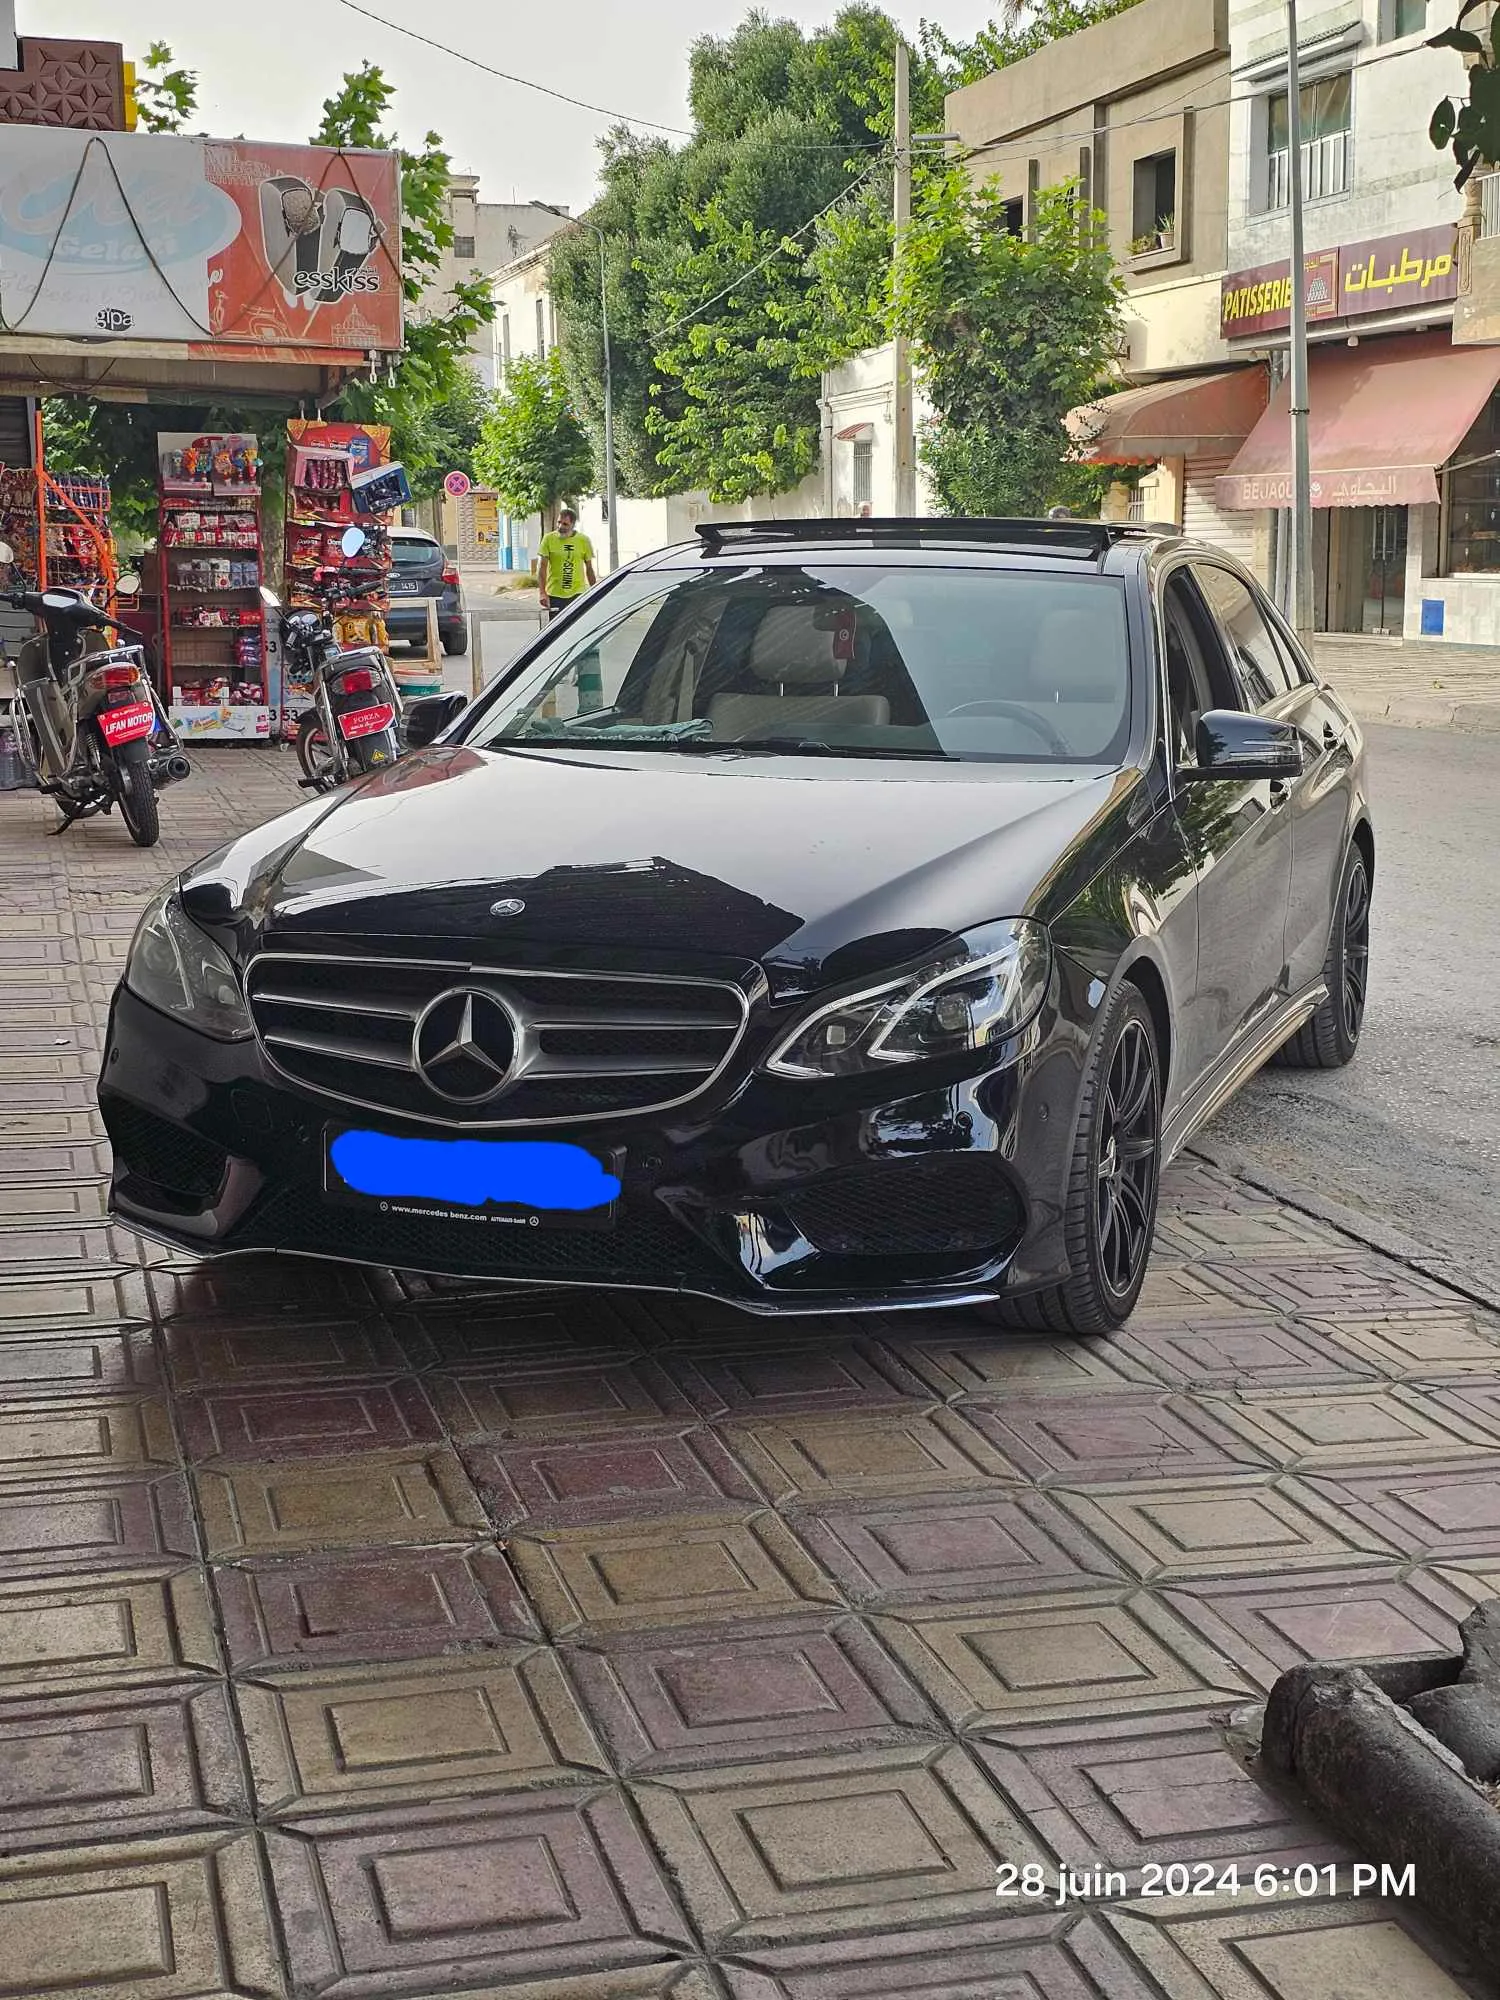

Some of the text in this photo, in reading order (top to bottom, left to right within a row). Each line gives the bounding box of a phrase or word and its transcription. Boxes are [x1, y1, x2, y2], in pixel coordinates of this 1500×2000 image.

[1344, 248, 1452, 293] مرطبات
[1223, 277, 1292, 320] PATISSERIE
[97, 308, 133, 330] gipa
[1243, 480, 1292, 500] BEJAOU
[105, 719, 127, 735] LIFAN
[127, 711, 153, 728] MOTOR
